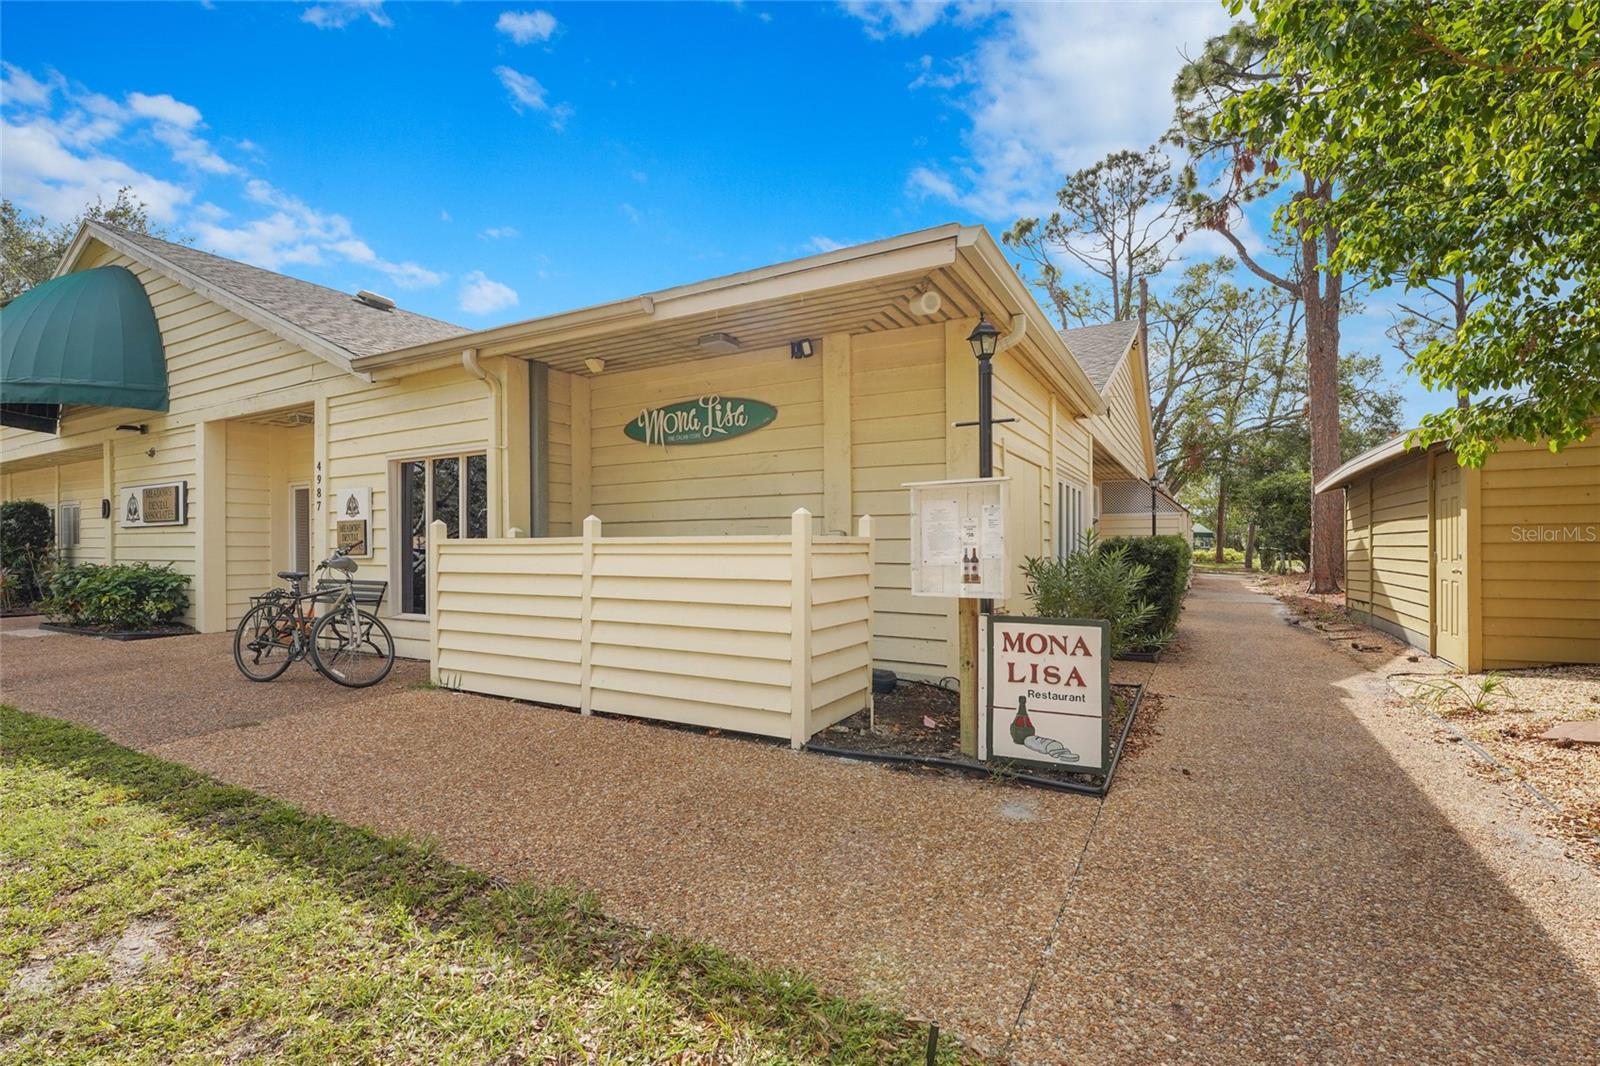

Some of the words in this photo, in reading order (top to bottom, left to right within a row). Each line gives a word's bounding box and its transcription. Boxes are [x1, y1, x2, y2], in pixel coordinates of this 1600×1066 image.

[638, 407, 701, 448] Mona
[699, 394, 749, 438] Lisa
[148, 500, 169, 510] DENTAL
[144, 510, 175, 521] ASSOCIATES
[1002, 631, 1093, 657] MONA
[1007, 662, 1087, 687] LISA
[1027, 689, 1086, 703] Restaurant
